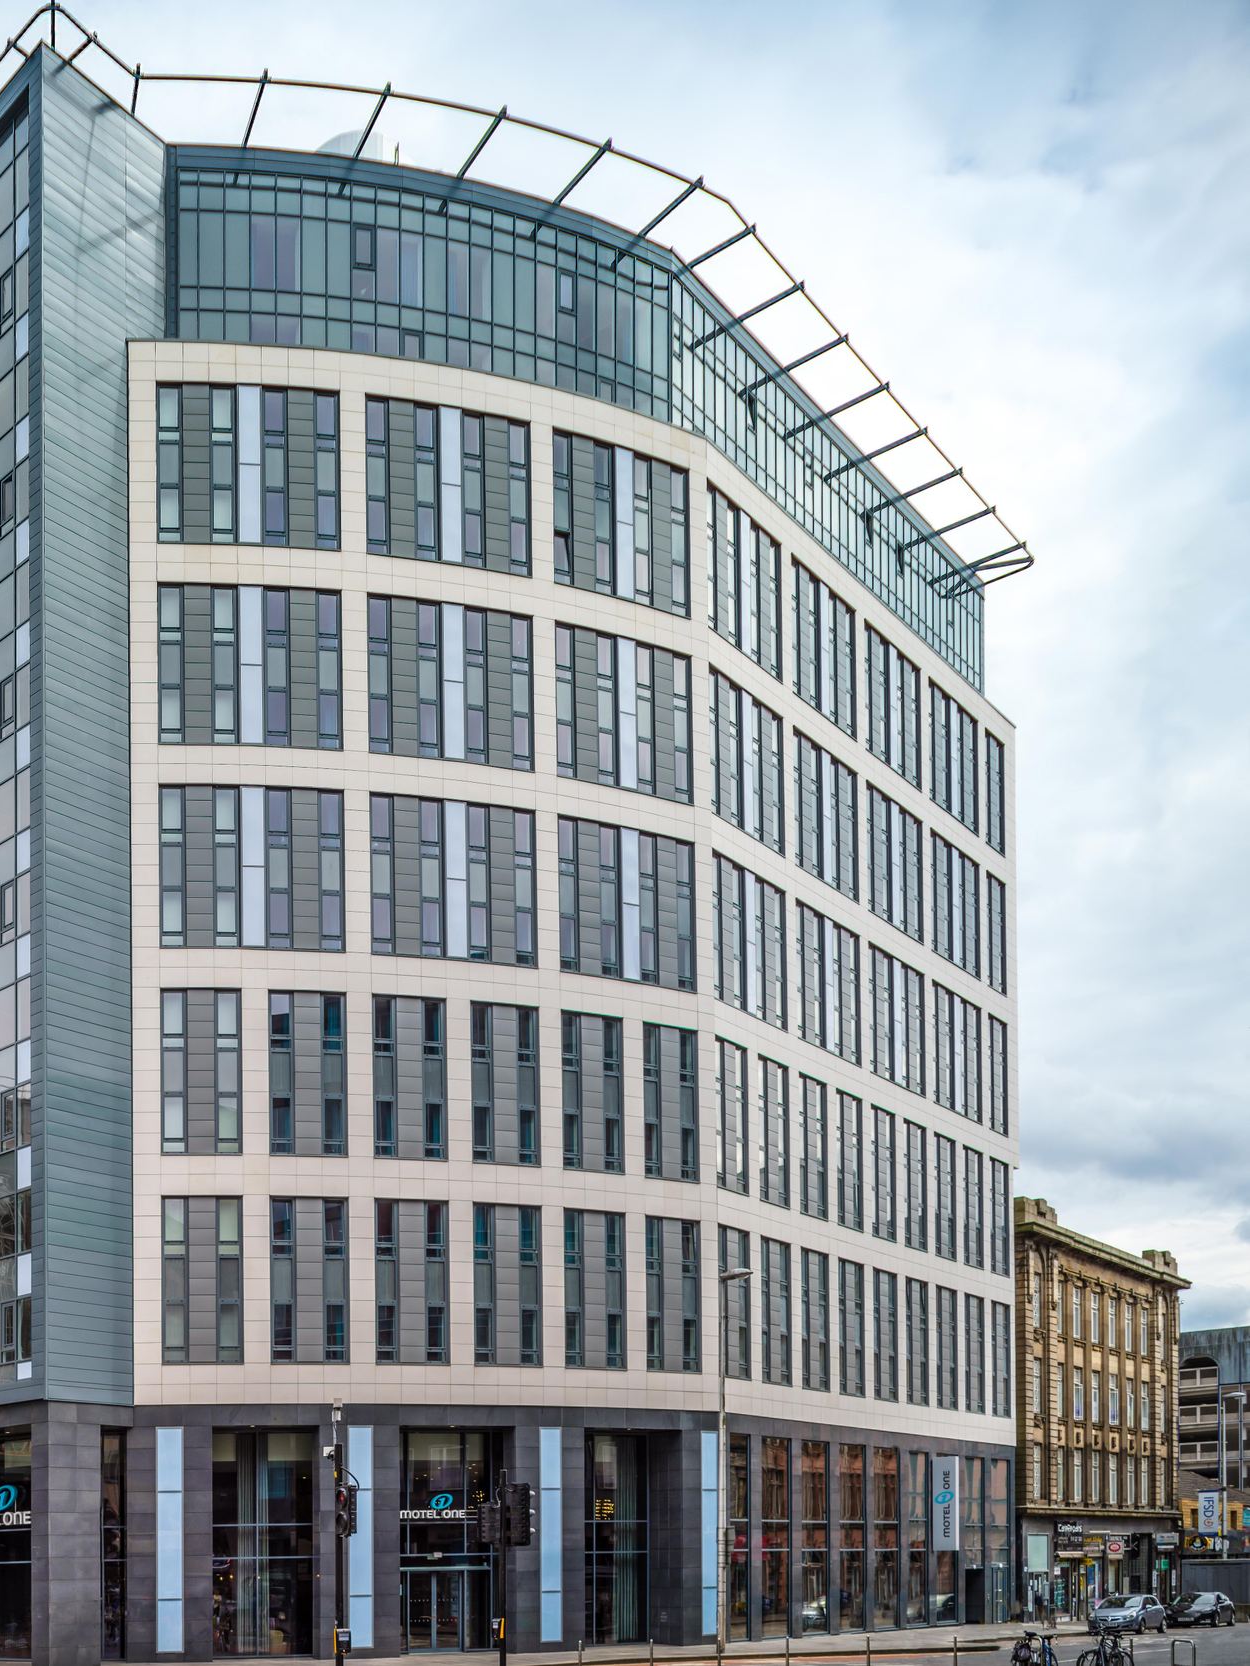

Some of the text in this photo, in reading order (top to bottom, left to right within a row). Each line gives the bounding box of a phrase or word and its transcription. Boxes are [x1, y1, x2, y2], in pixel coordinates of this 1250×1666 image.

[942, 1470, 951, 1490] ONE
[399, 1509, 466, 1519] MOTEL ONE
[1203, 1496, 1215, 1518] IFSD
[2, 1510, 31, 1526] ONE
[942, 1503, 951, 1538] MOTEL
